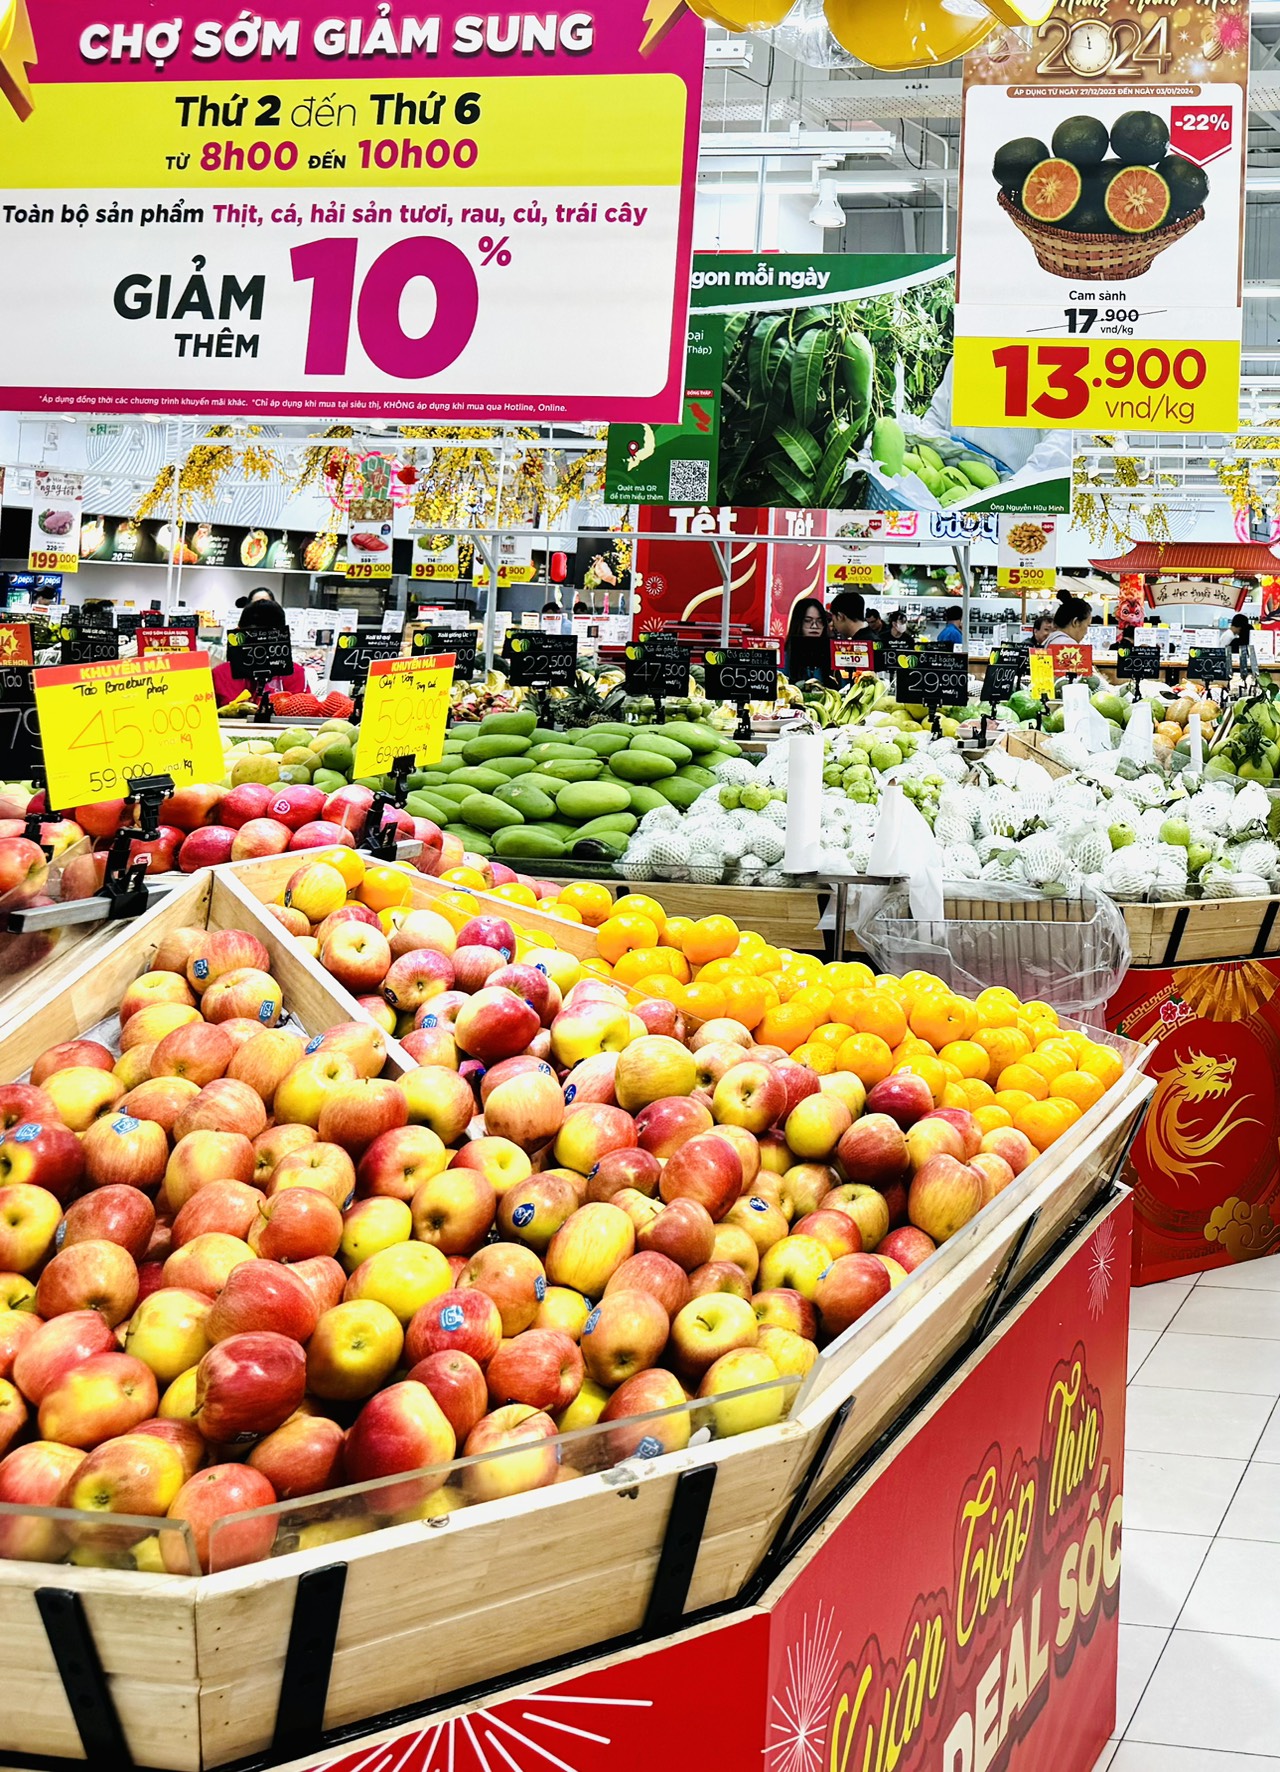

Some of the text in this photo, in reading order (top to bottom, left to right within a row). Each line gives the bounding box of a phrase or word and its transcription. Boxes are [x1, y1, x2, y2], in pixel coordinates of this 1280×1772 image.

[79, 3, 594, 70] CHỢ SỚM GIẢM SUNG
[175, 91, 481, 128] Thứ 2 đến Thứ 6
[1174, 114, 1230, 131] -22%
[165, 138, 478, 171] TỪ 8h00 ĐẾN 10h00
[2, 198, 648, 228] Toàn bộ sản phẩm Thịt, cá, hải sản tươi, rau, củ, trái cây
[113, 254, 266, 320] GIẢM
[735, 263, 774, 285] mỗi
[778, 268, 830, 290] ngày
[1069, 290, 1126, 301] Cam sành
[1064, 308, 1139, 333] 17.900
[1100, 325, 1134, 335] vnd/kg
[174, 326, 260, 358] THÊM
[993, 344, 1206, 419] 13.900
[115, 396, 128, 405] các
[383, 399, 415, 410] KHÔNG
[452, 402, 465, 410] khi
[486, 404, 501, 413] qua
[1105, 393, 1194, 424] vnd/kg
[990, 502, 1005, 512] Ông
[1006, 503, 1031, 513] Nguyễn
[1048, 504, 1064, 512] Minh
[31, 552, 76, 569] 199.000
[347, 564, 390, 577] 479.000
[415, 565, 454, 577] 99.000
[834, 566, 871, 581] 4.900
[1008, 569, 1044, 584] 5.900
[243, 645, 289, 665] 39.900
[391, 659, 420, 672] KHUYẾN
[522, 655, 572, 675] 22.500
[80, 657, 171, 680] KHUYẾN MÃI
[633, 662, 686, 682] 47.500
[720, 667, 775, 689] 65.900
[908, 671, 968, 693] 29.900
[68, 704, 202, 763] 45.000
[943, 1588, 1048, 1772] DEAL
